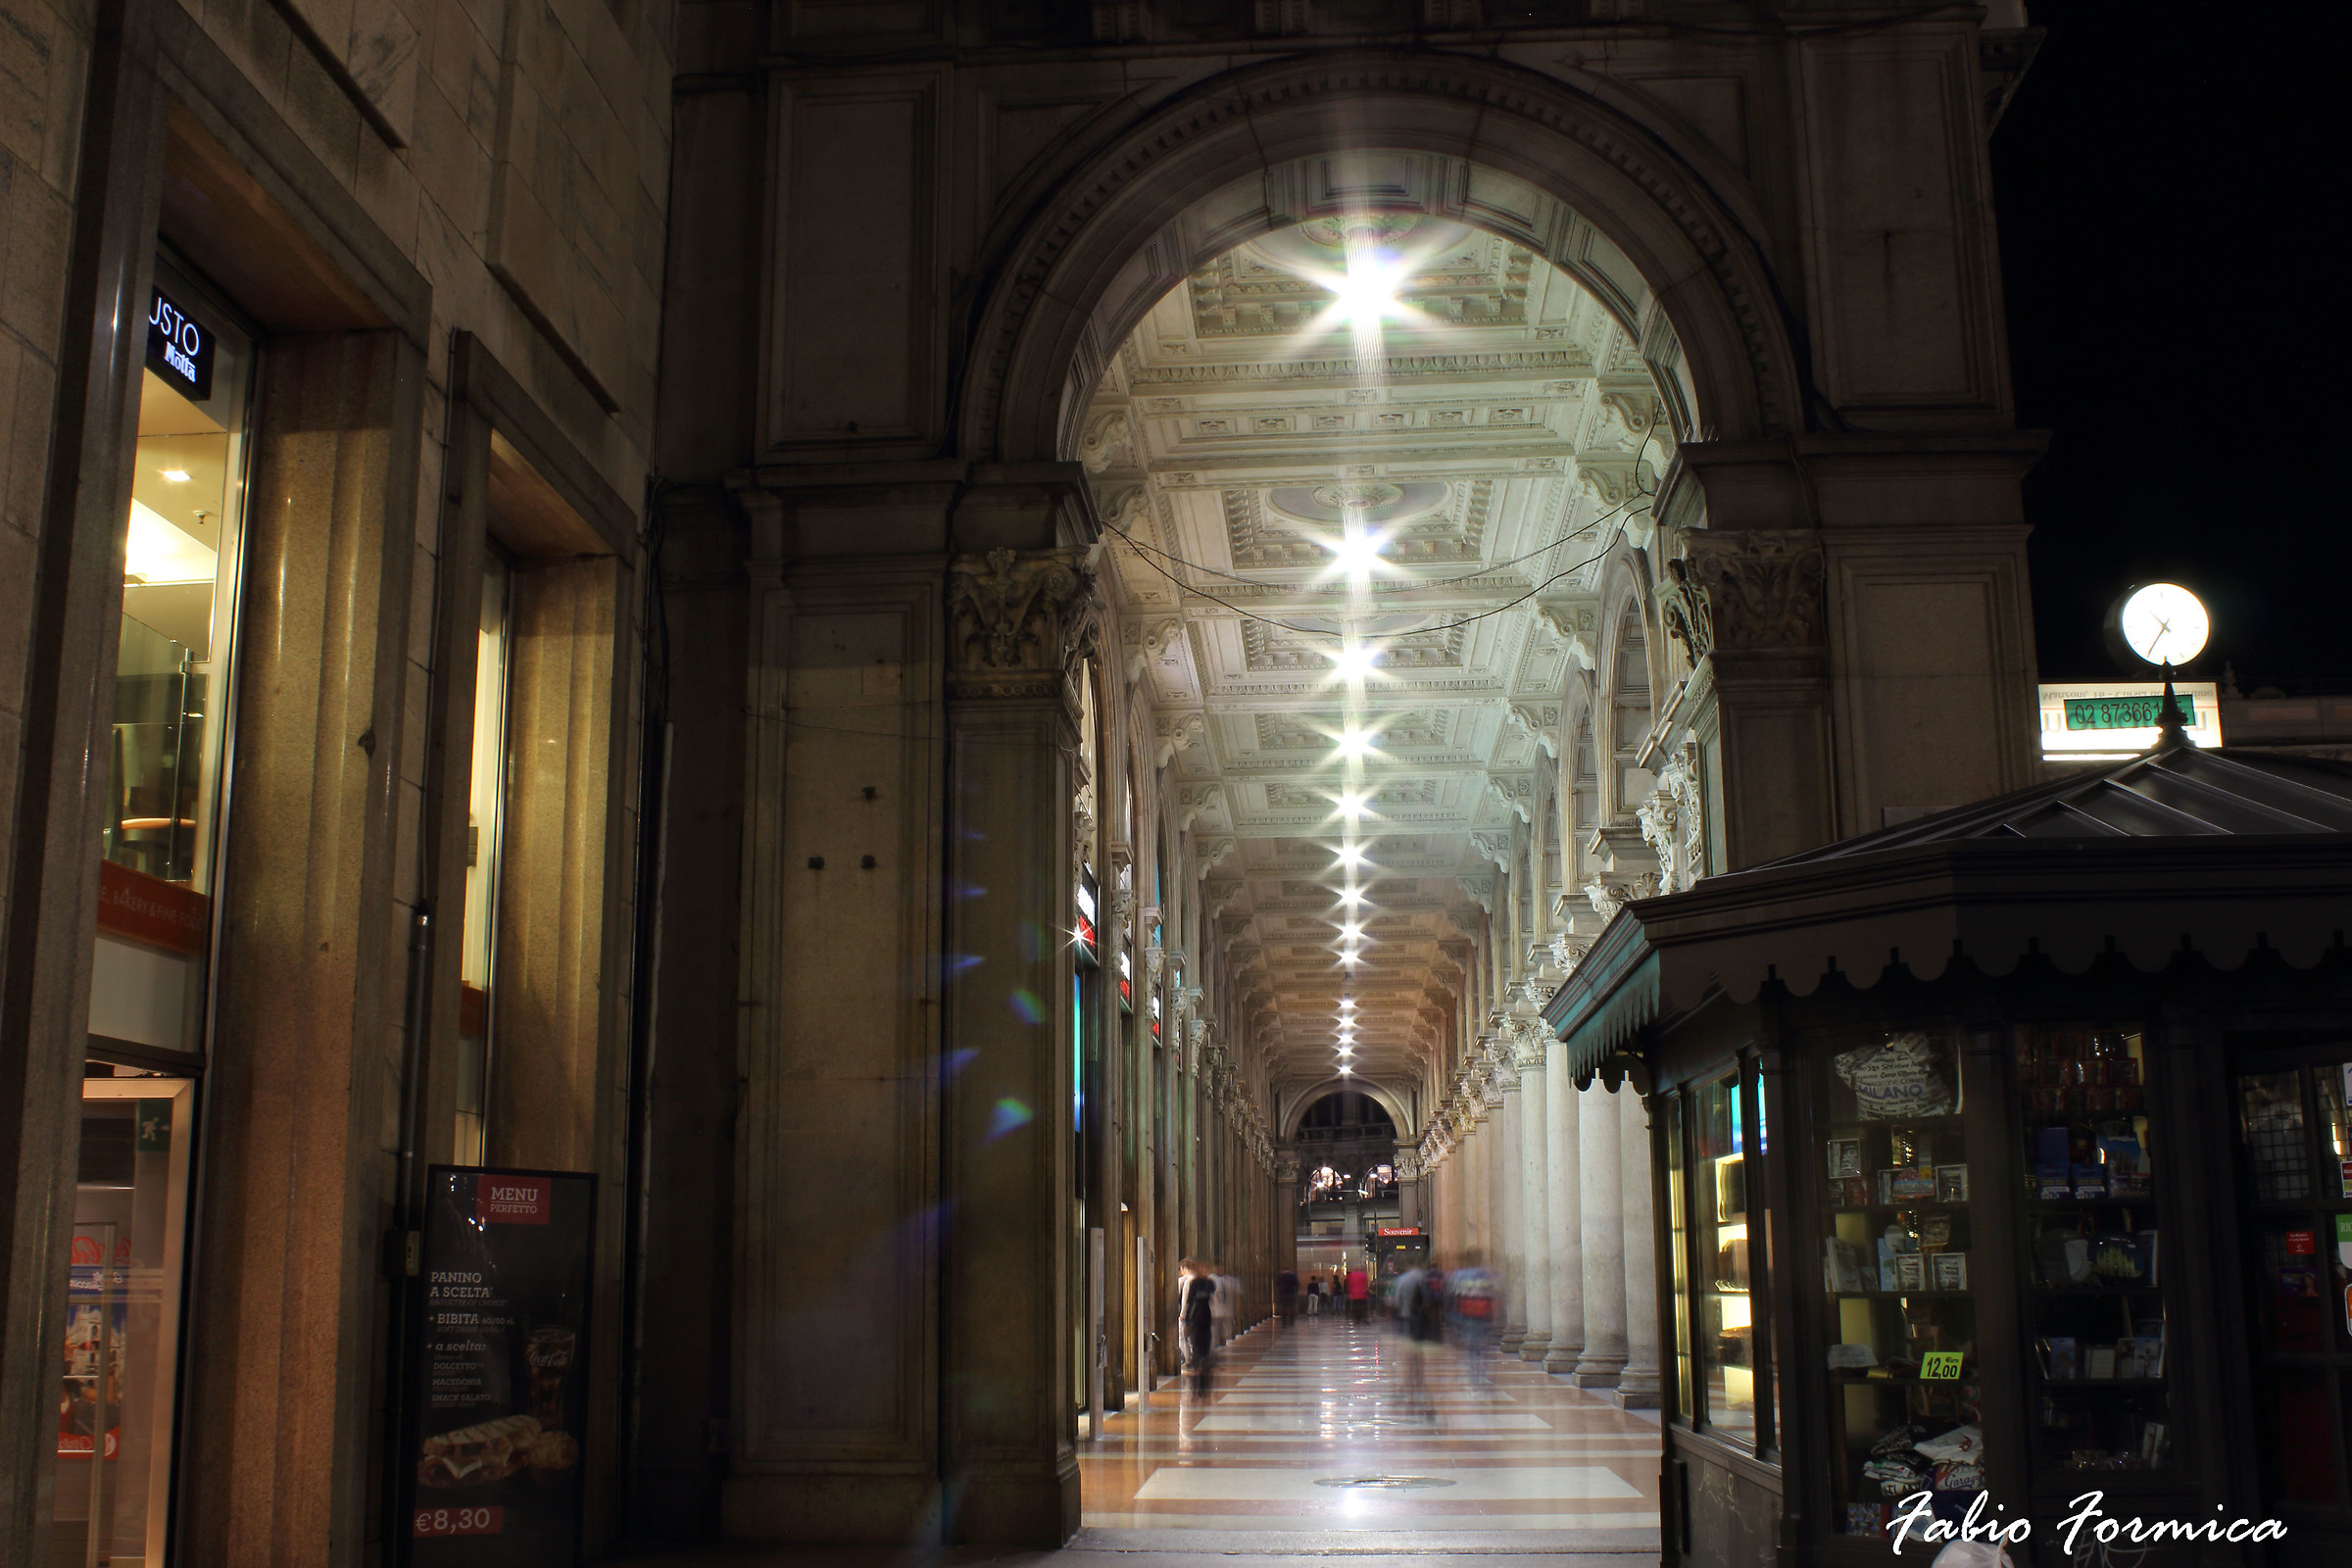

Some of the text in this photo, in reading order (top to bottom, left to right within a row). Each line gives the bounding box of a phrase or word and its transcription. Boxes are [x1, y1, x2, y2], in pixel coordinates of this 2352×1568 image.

[164, 341, 196, 383] Motta
[2075, 705, 2095, 724] 02
[113, 890, 150, 913] BAKERY
[148, 902, 156, 917] &
[157, 905, 177, 923] FINE
[1858, 1084, 1923, 1100] MILANO
[491, 1187, 539, 1201] MENU
[490, 1204, 538, 1214] PERFETTO
[430, 1272, 482, 1284] PANINO
[429, 1287, 440, 1298] A
[437, 1313, 479, 1325] BIBITA
[435, 1343, 444, 1351] a
[447, 1340, 487, 1352] scelta:
[1927, 1357, 1957, 1377] 12,00
[415, 1508, 490, 1534] €8,30
